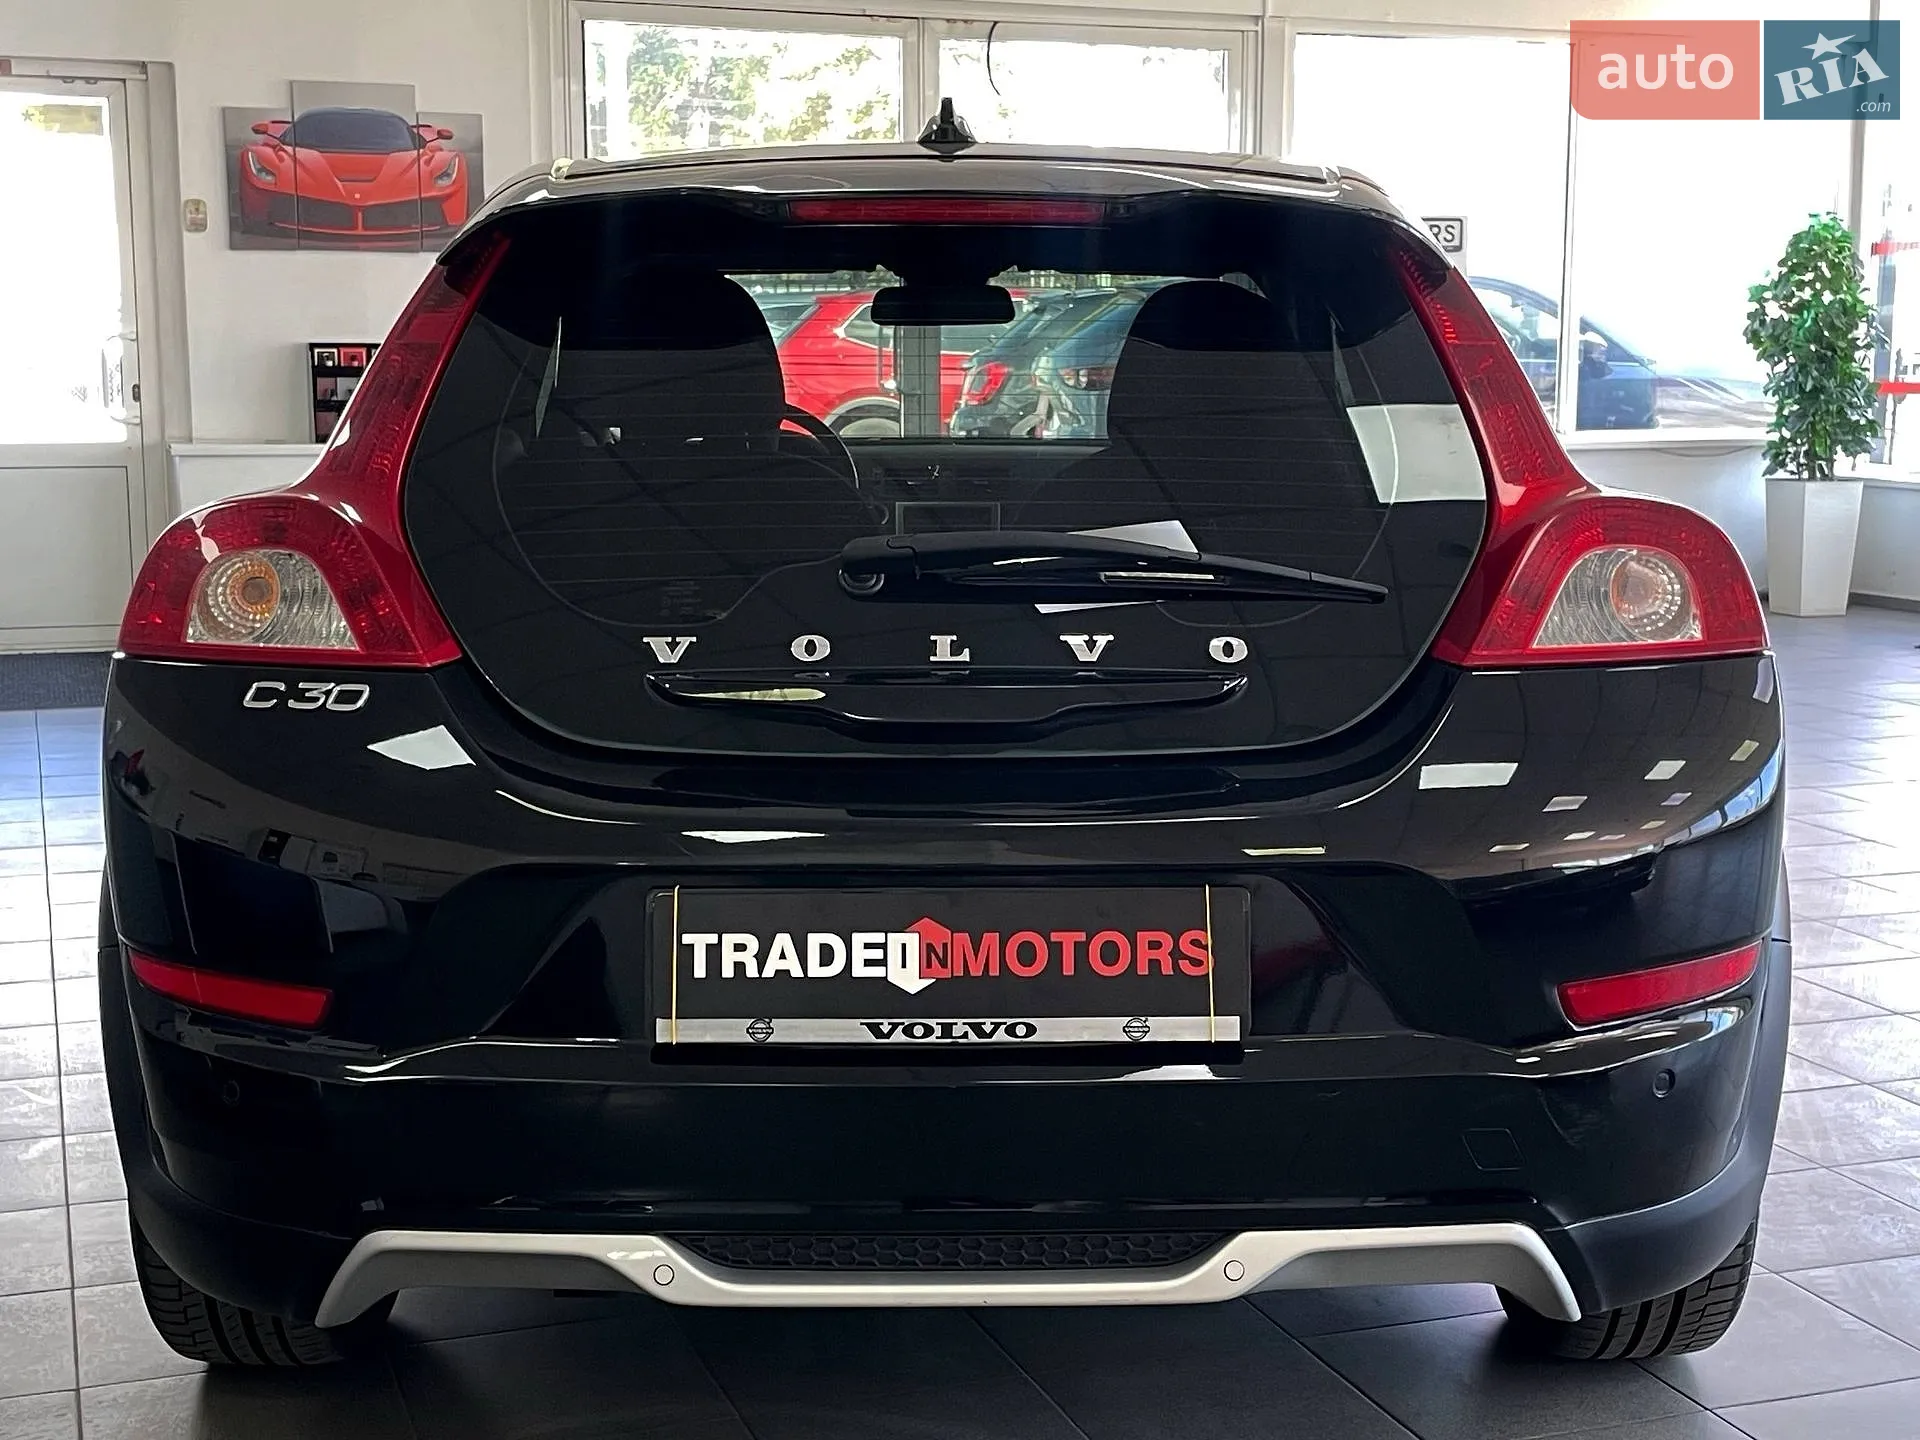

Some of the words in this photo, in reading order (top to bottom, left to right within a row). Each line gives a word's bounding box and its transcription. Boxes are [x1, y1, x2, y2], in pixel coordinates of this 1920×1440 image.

[643, 634, 1249, 663] VOLVO
[243, 681, 370, 711] C30
[861, 1021, 1037, 1039] VOLVO
